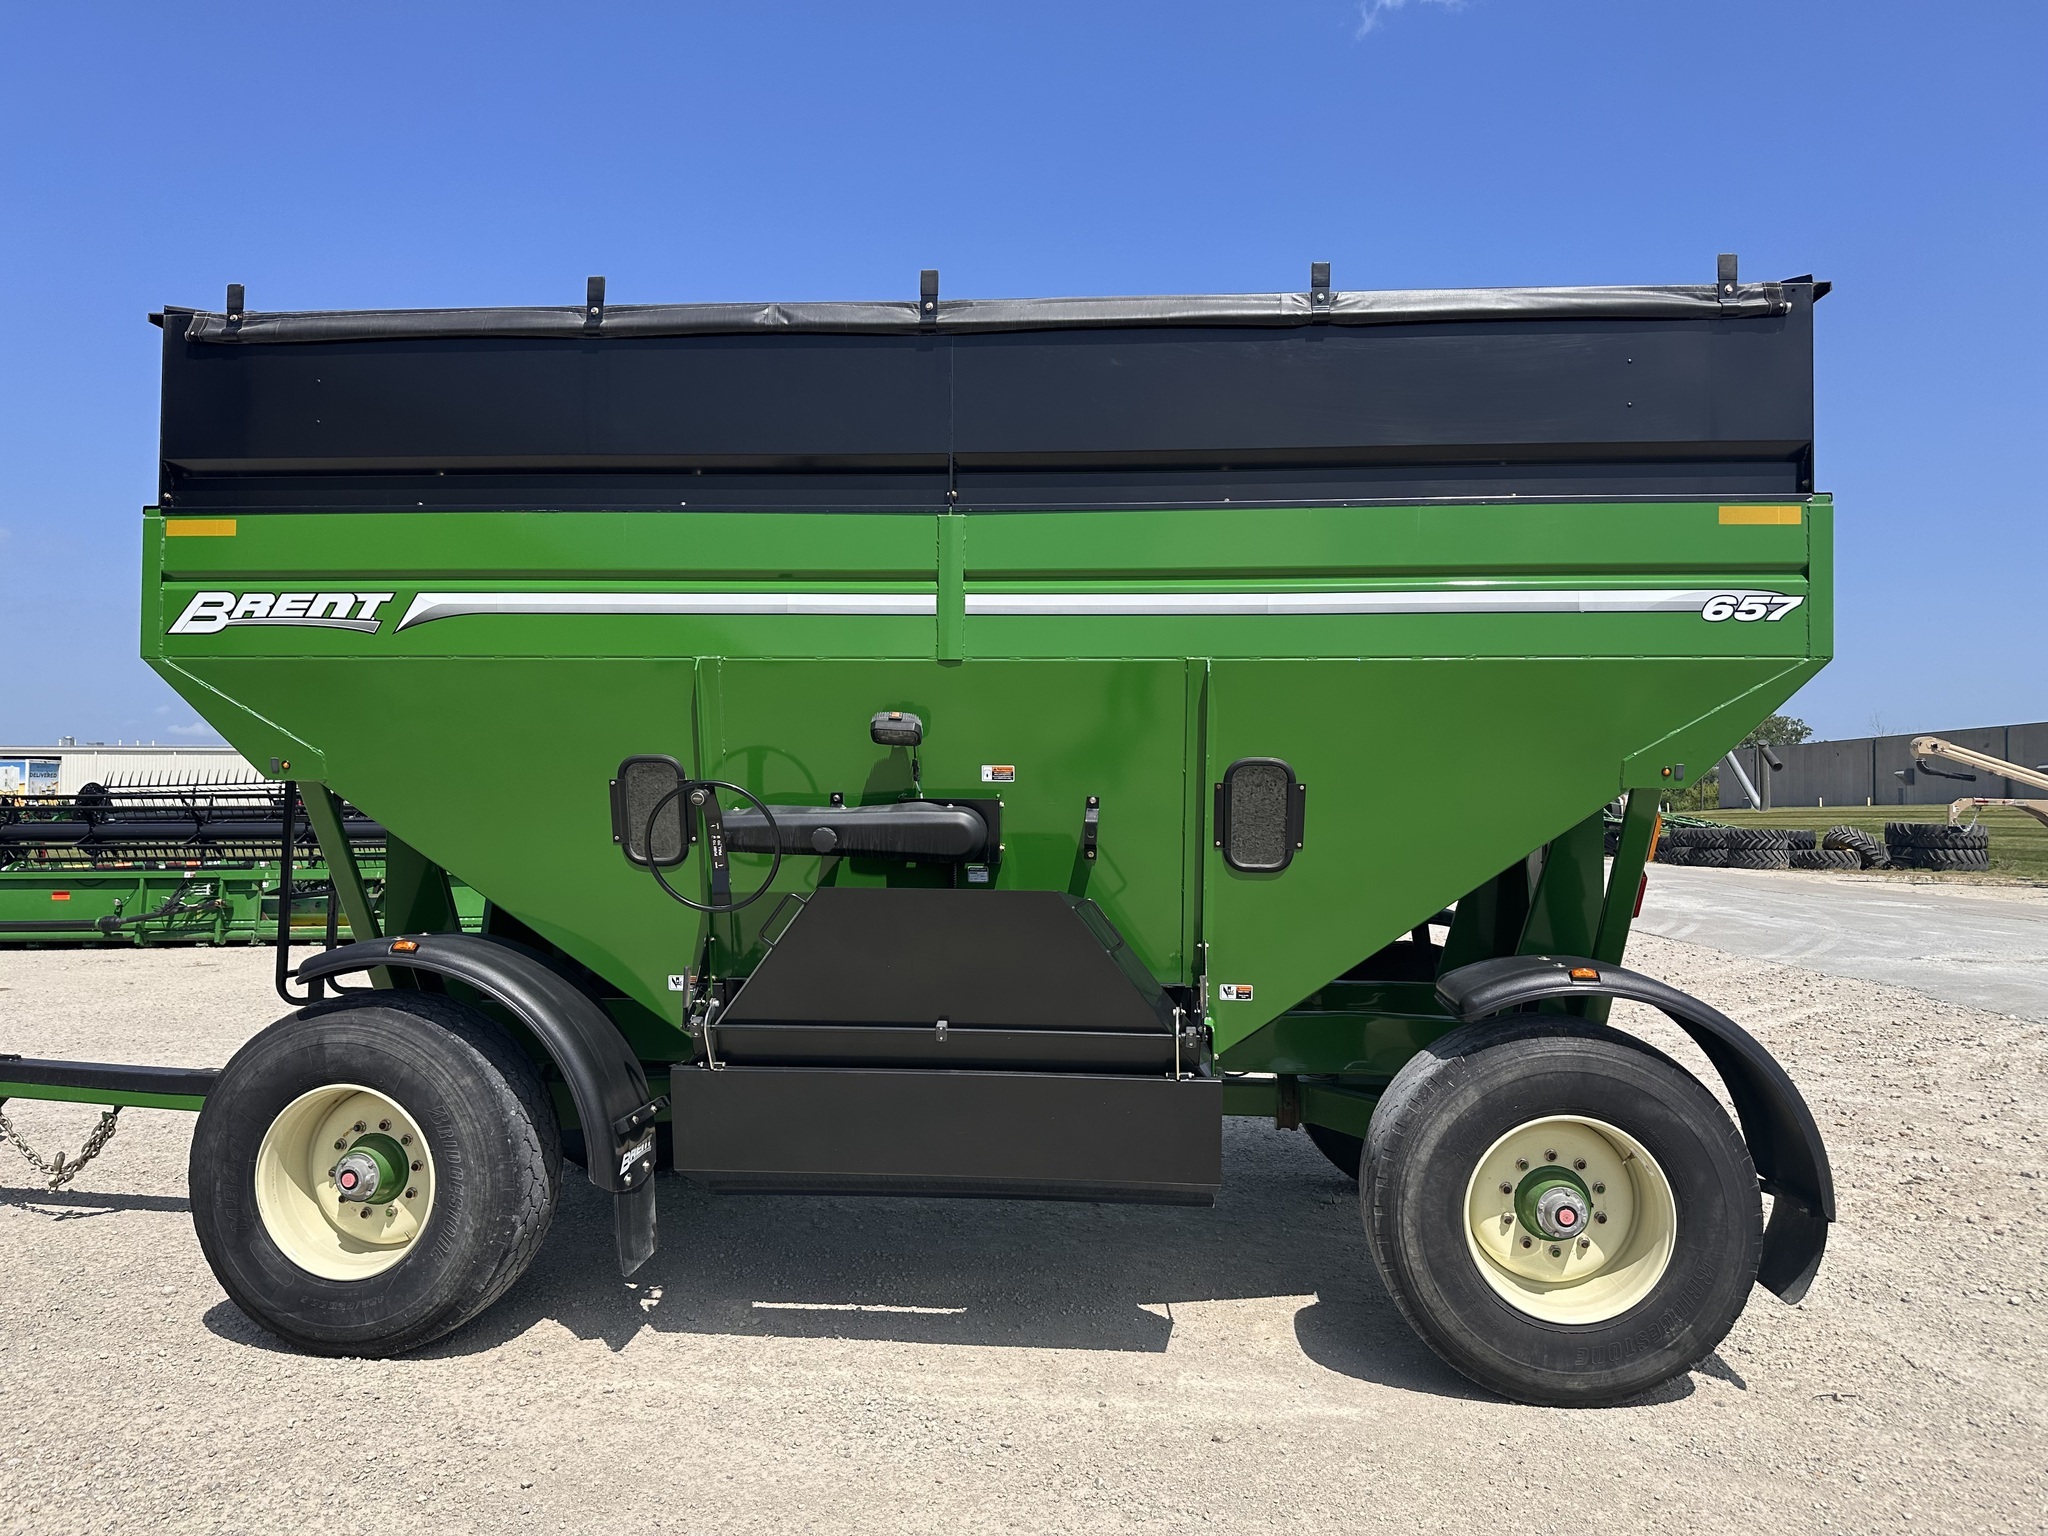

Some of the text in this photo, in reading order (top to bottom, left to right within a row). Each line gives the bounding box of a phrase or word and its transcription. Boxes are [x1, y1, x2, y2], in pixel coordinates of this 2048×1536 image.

[167, 591, 396, 634] BRENT
[1701, 594, 1806, 622] 657
[29, 771, 58, 779] DELIVERED
[619, 1133, 653, 1176] BRENT
[424, 1105, 464, 1266] BRIDGESTONE
[1574, 1255, 1717, 1366] BRIDGESTONE
